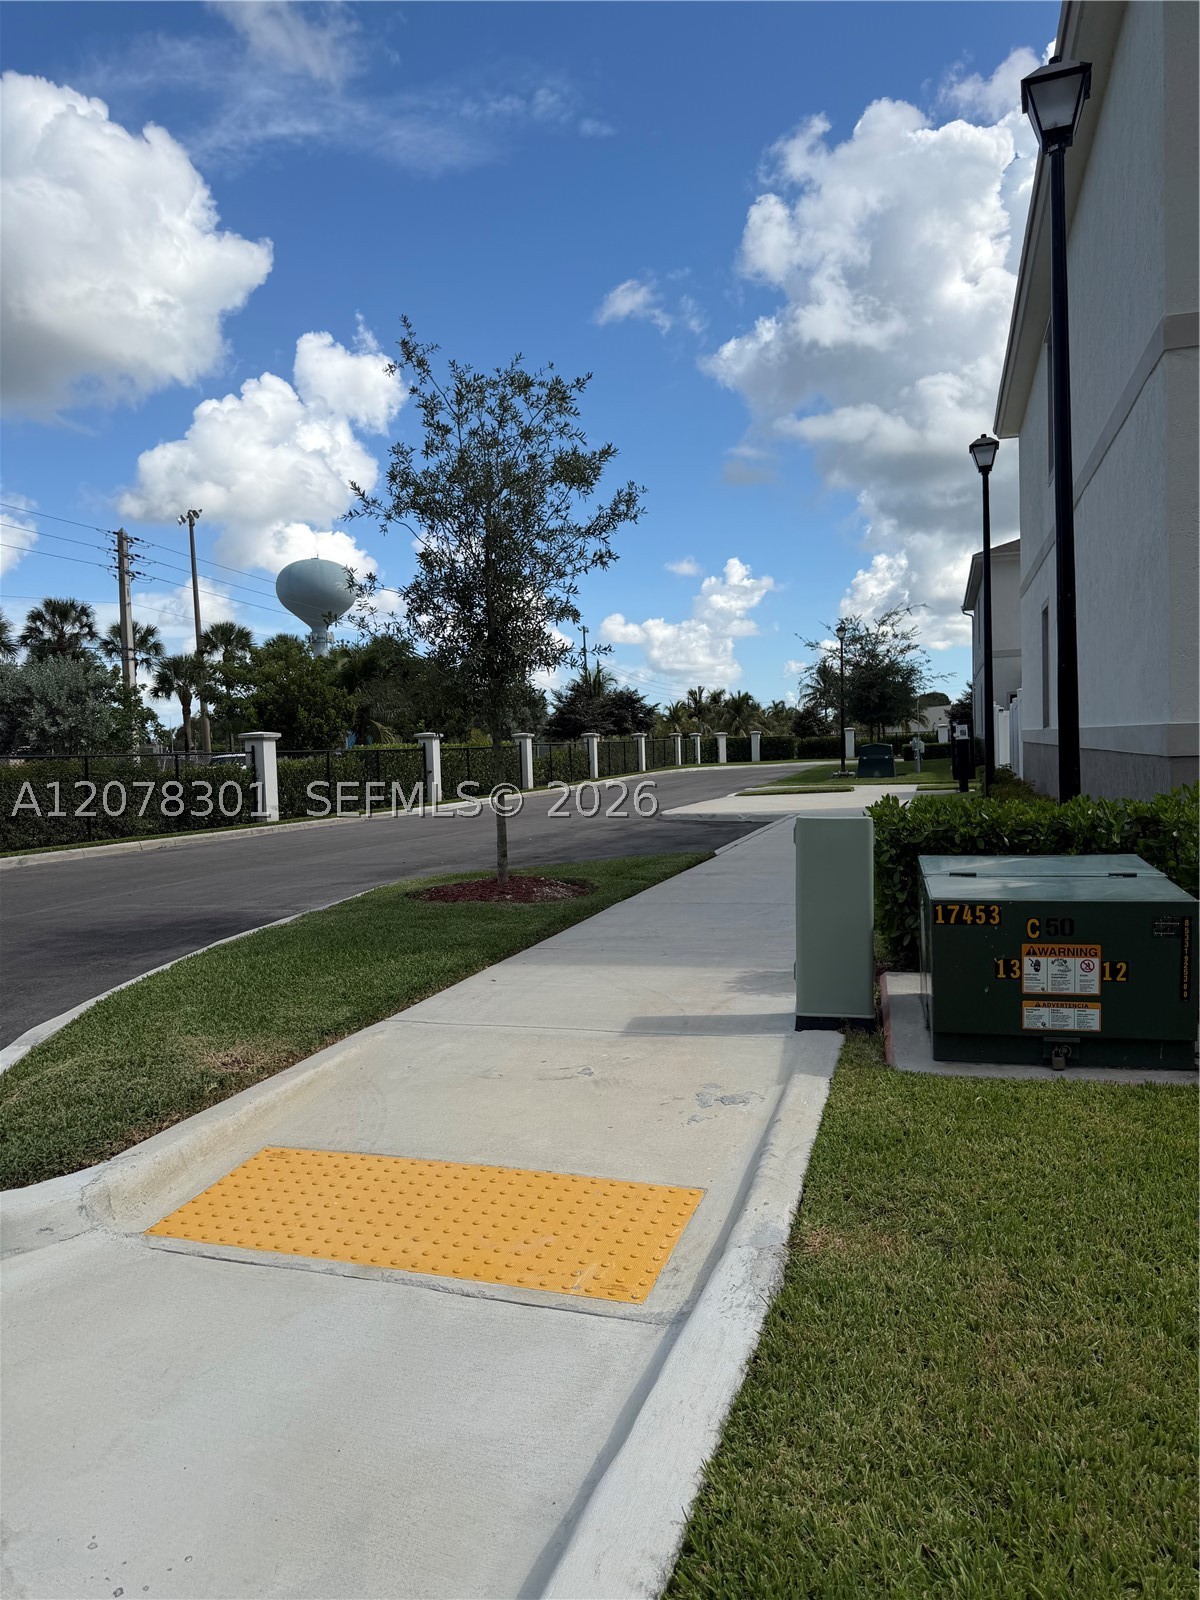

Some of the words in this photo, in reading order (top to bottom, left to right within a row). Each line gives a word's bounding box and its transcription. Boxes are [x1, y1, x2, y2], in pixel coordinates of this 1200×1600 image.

[935, 904, 1001, 925] 17453
[1026, 918, 1040, 939] C
[1045, 917, 1075, 937] 50
[1037, 947, 1098, 957] WARNING
[1102, 961, 1128, 982] 12
